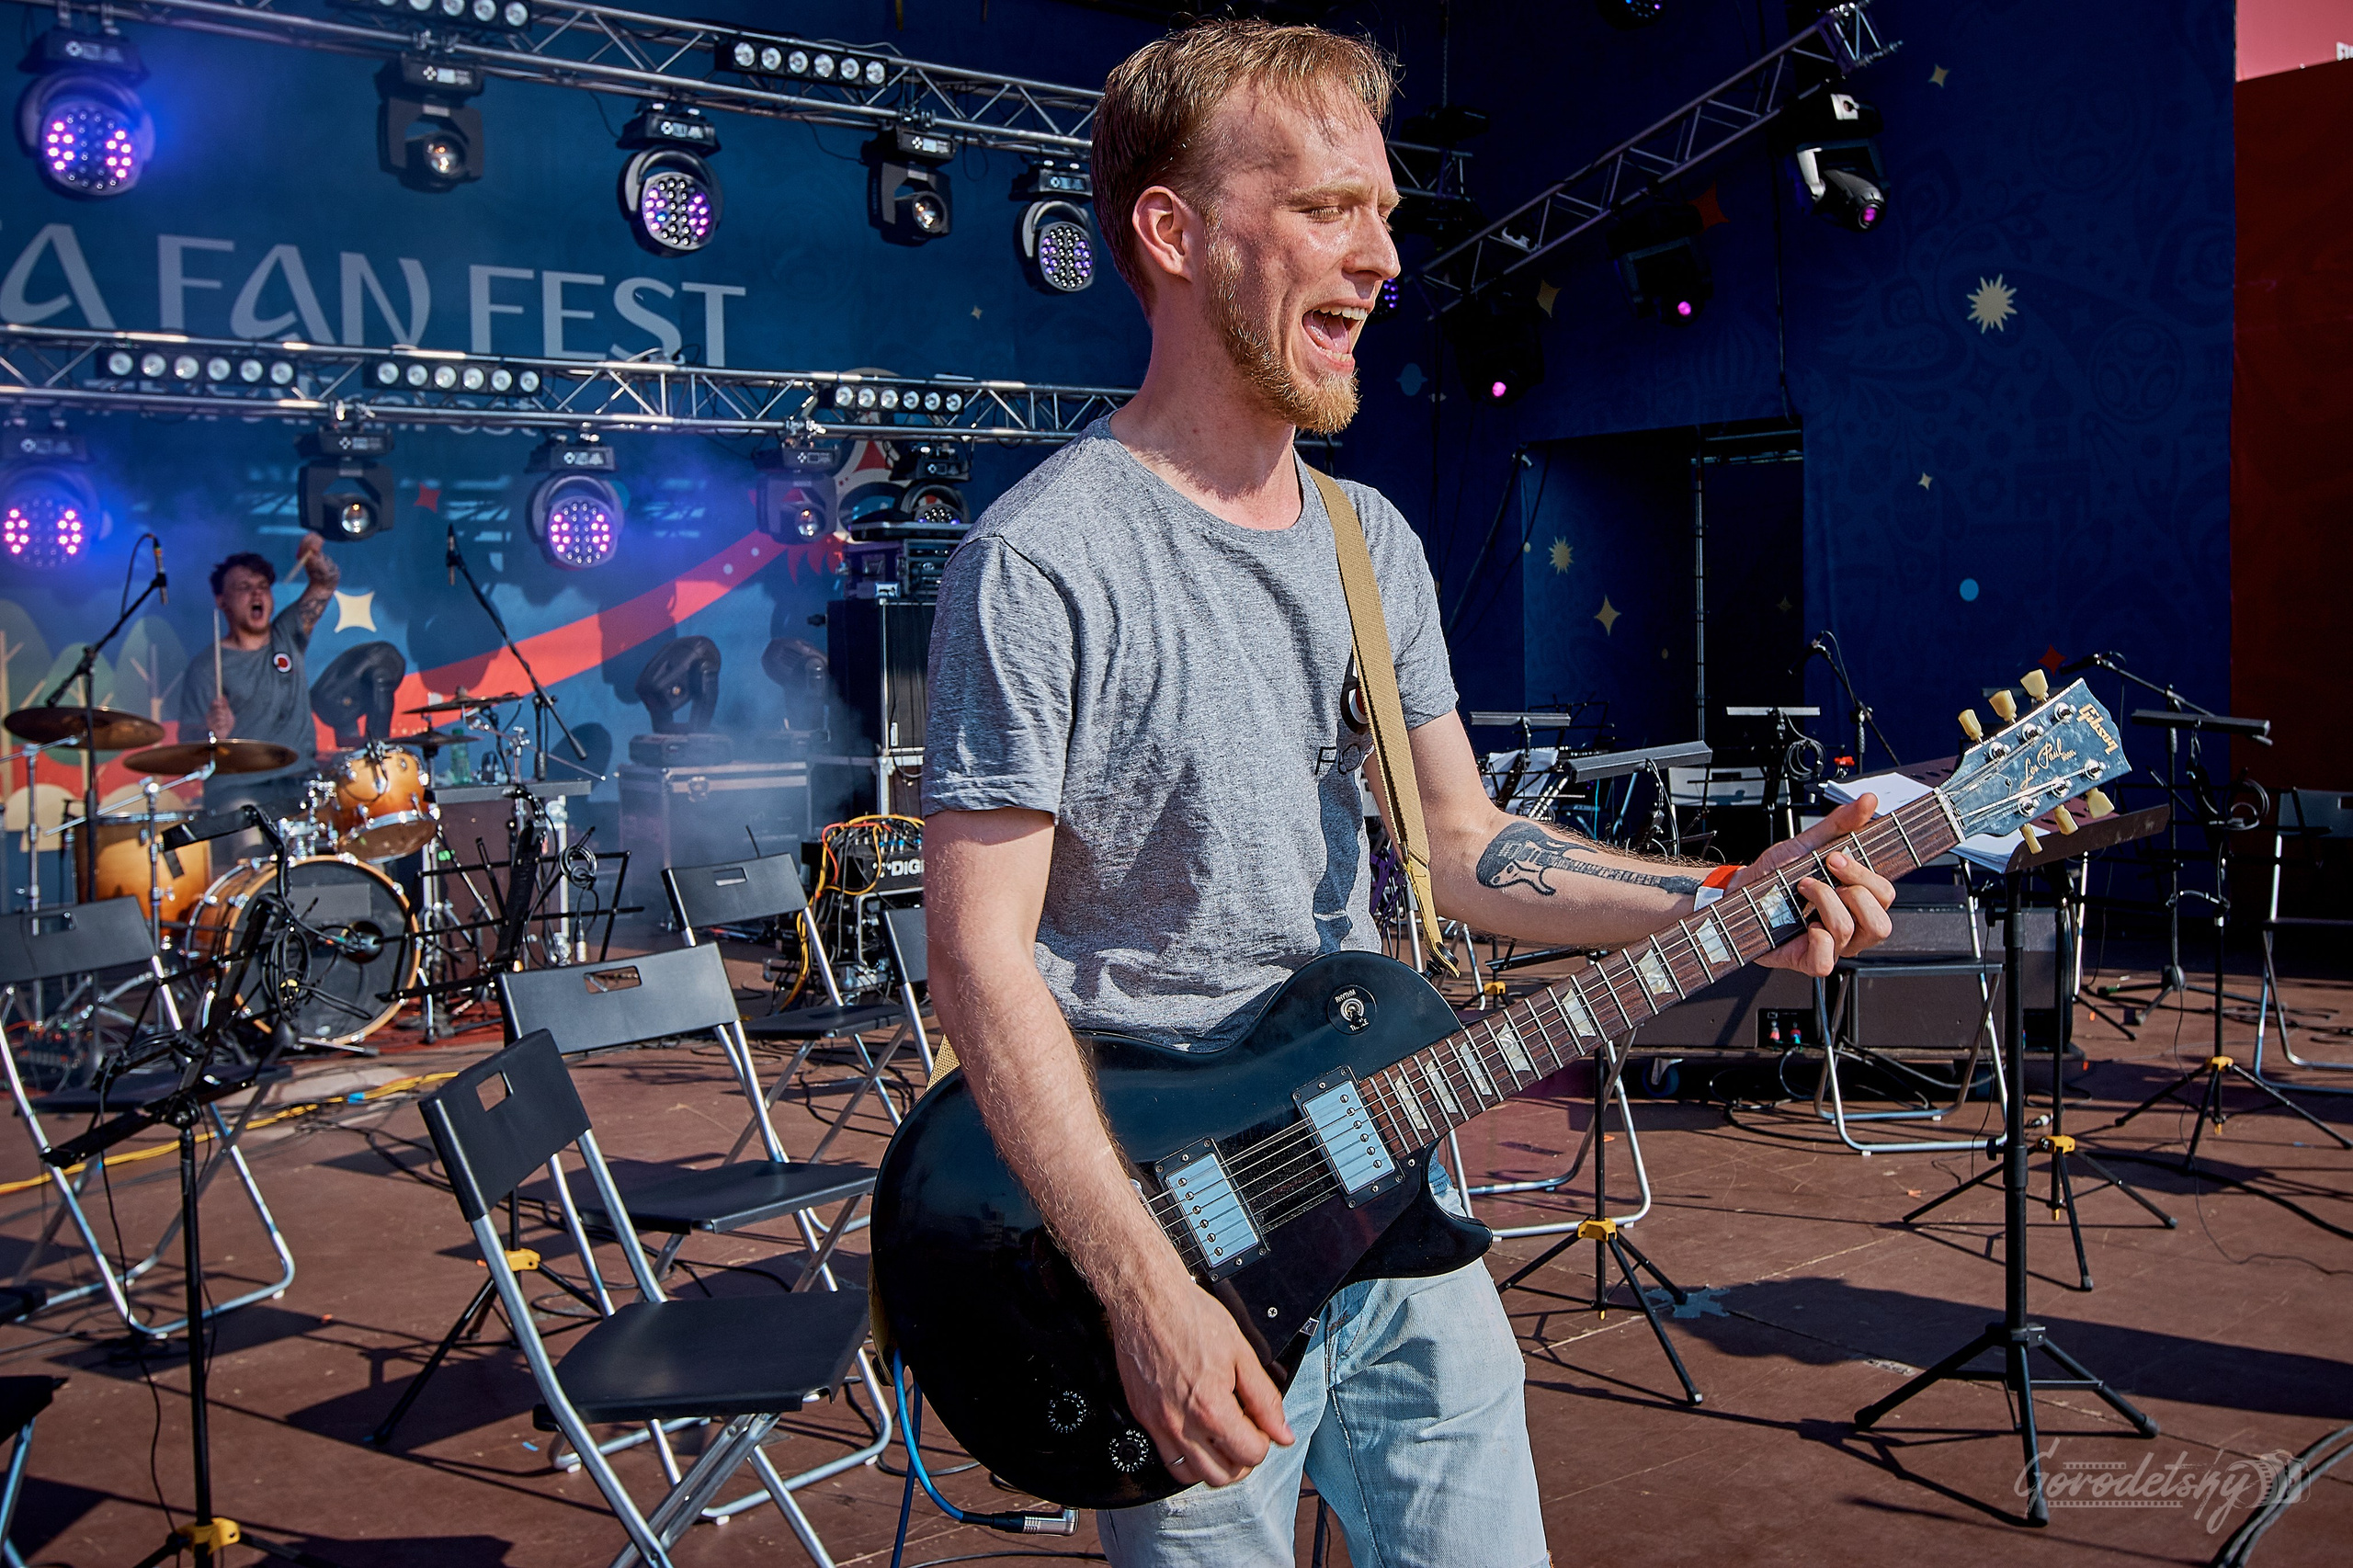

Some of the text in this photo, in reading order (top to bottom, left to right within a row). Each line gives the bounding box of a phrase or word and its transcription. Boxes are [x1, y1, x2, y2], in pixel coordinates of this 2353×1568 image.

[157, 234, 431, 347] FAN
[470, 265, 746, 368] FEST
[2076, 703, 2119, 756] Gibson
[2037, 737, 2063, 769] Paul
[1335, 989, 1357, 1004] RHYTHM
